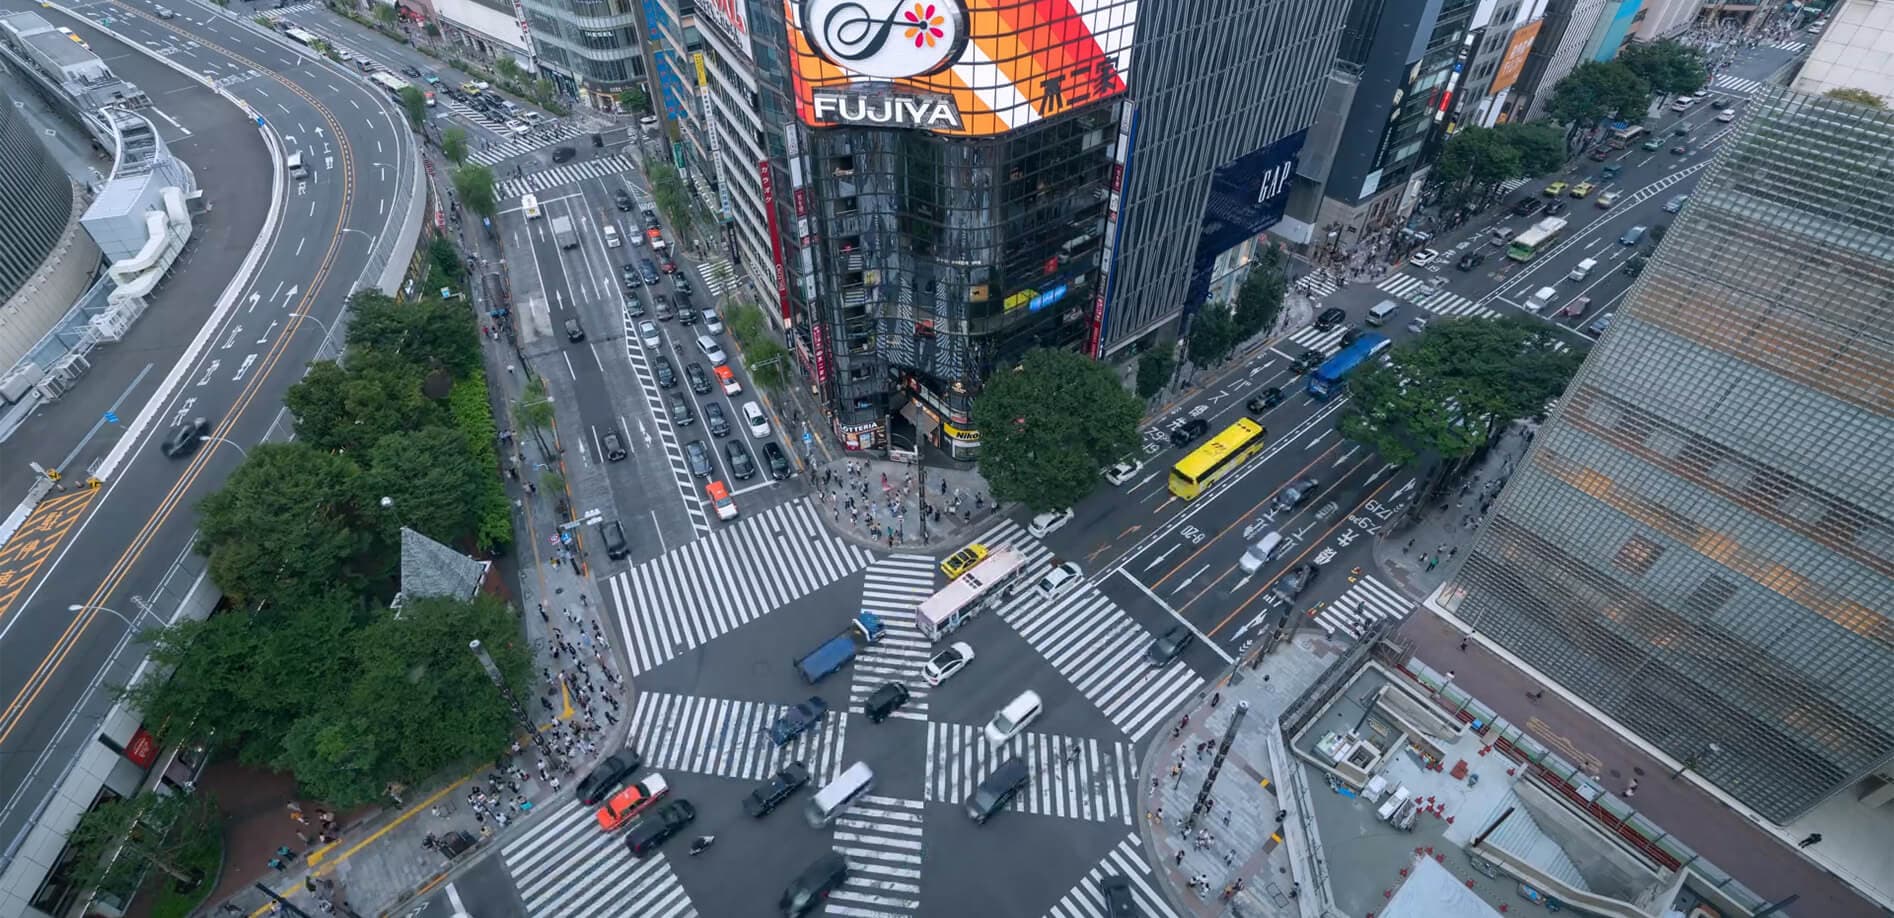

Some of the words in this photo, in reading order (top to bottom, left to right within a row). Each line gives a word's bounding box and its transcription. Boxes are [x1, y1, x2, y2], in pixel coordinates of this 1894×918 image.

[1038, 55, 1119, 117] 不二家
[814, 93, 957, 126] FUJIYA
[760, 166, 774, 204] カラオケ
[1258, 161, 1292, 203] GAP
